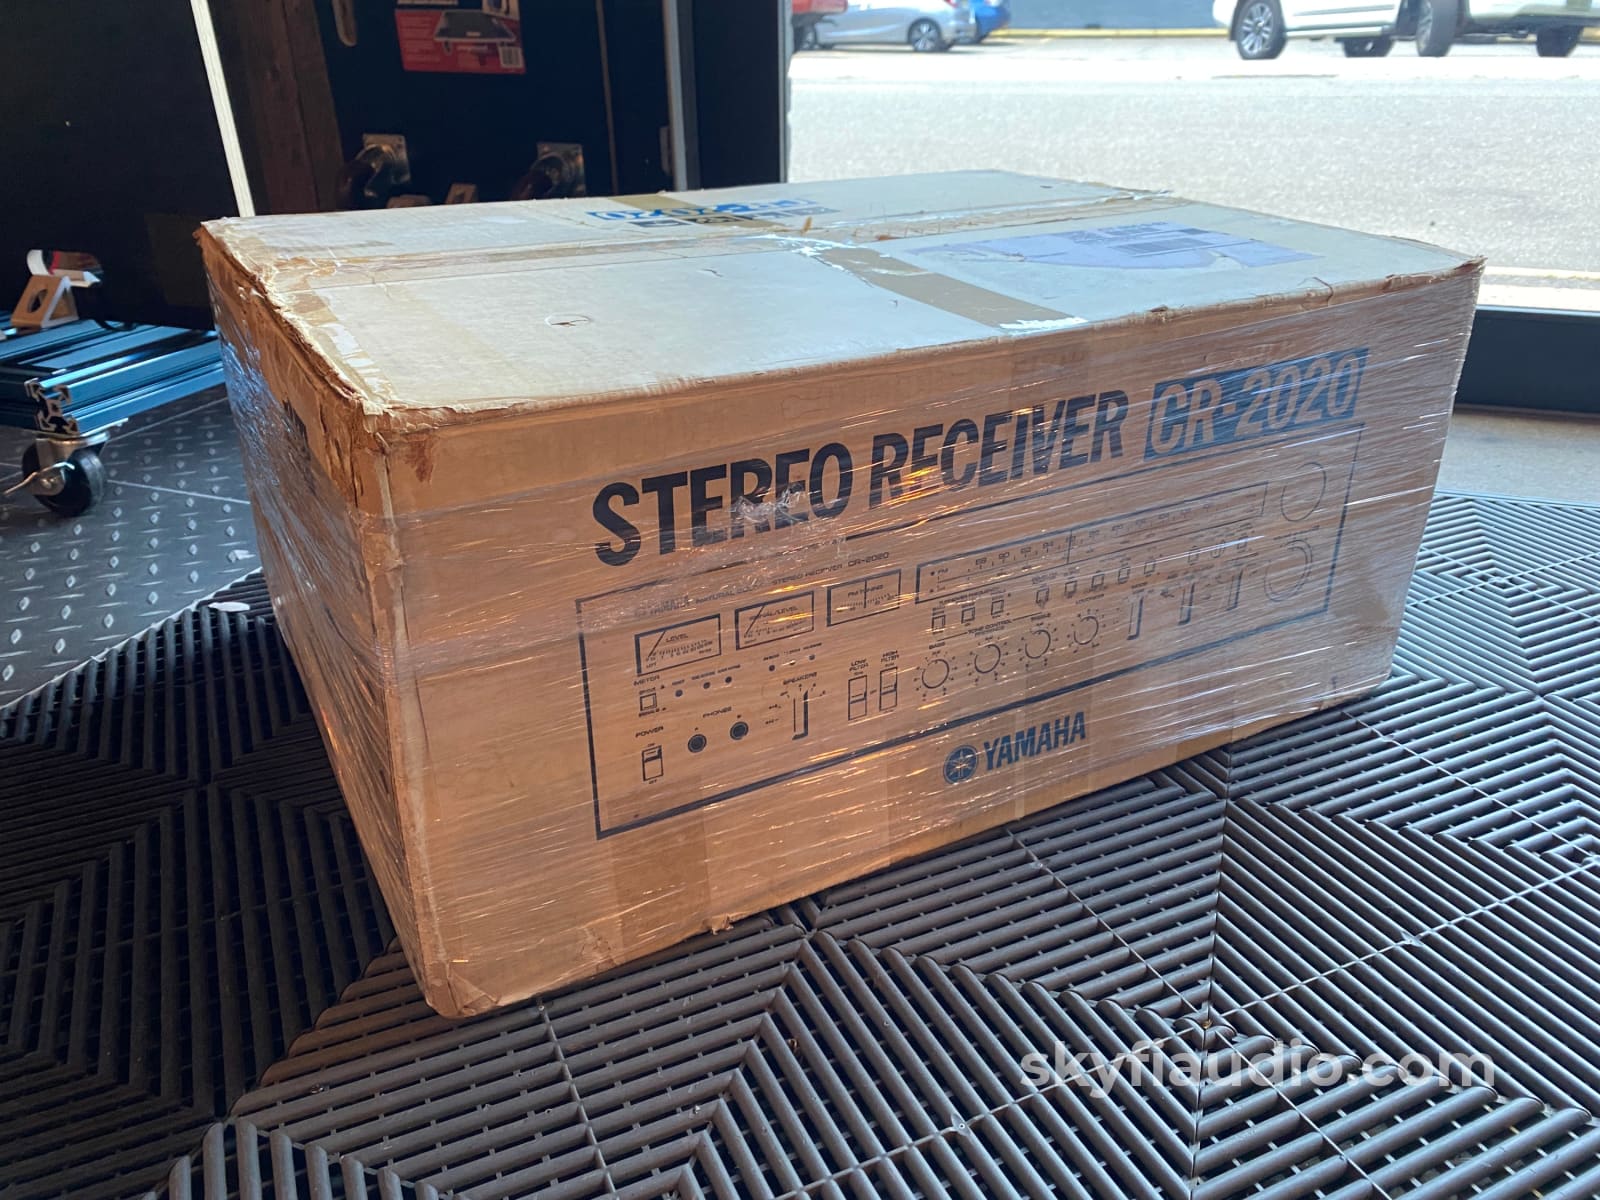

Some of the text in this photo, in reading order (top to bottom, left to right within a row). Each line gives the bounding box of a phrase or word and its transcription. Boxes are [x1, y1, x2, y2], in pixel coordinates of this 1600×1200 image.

[592, 351, 1363, 567] STEREO RECEIVER CR-2020
[771, 573, 804, 585] STEREO
[847, 551, 890, 567] CR-2020
[665, 633, 689, 643] LEVEL
[633, 675, 661, 687] METER
[702, 706, 733, 719] PHONES
[635, 726, 664, 739] POWER
[983, 711, 1087, 771] YAMAHA
